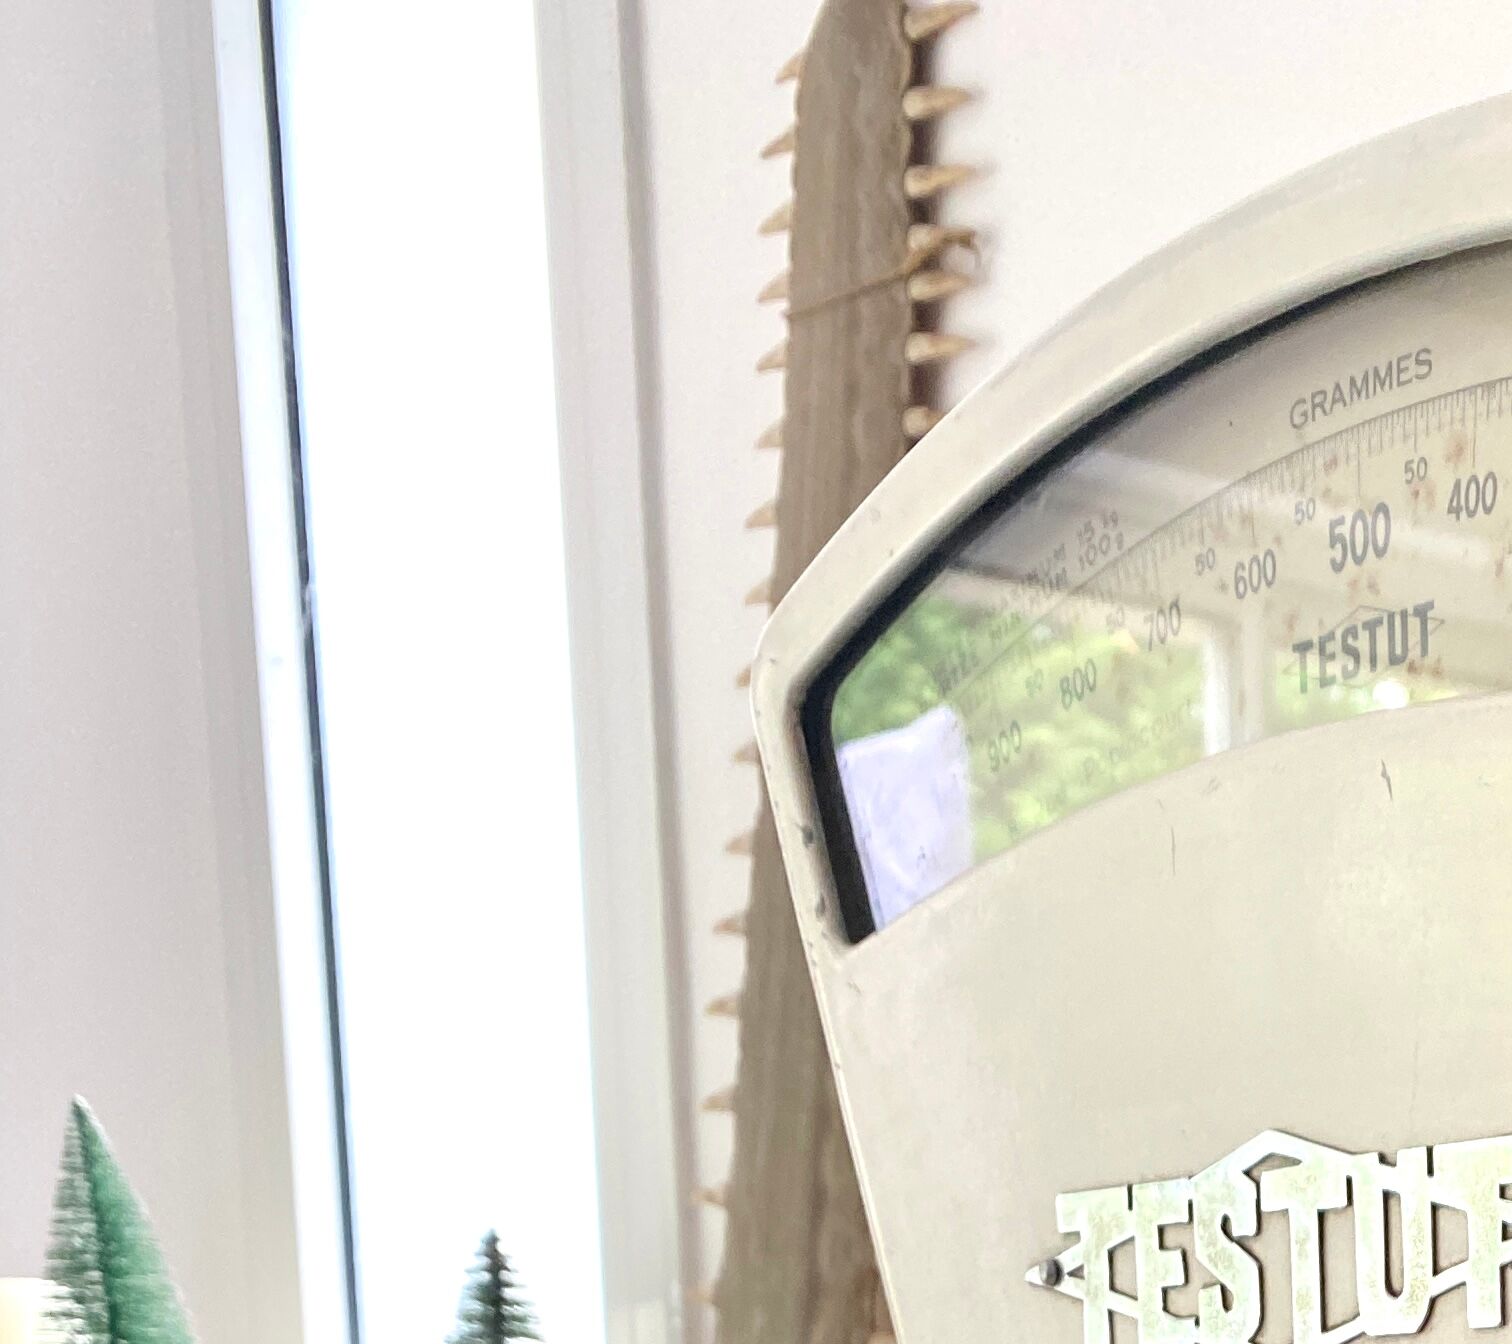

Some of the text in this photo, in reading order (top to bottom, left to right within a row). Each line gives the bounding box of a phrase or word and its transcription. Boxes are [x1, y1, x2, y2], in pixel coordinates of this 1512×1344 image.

[1290, 348, 1433, 430] GRAMMES
[1293, 498, 1316, 526] 50
[1404, 456, 1428, 485] 50
[1060, 657, 1097, 711] 800
[1143, 599, 1181, 652] 700
[1234, 548, 1277, 600] 600
[1328, 502, 1392, 574] 500
[1447, 471, 1498, 521] 400
[1291, 600, 1435, 695] TESTUT
